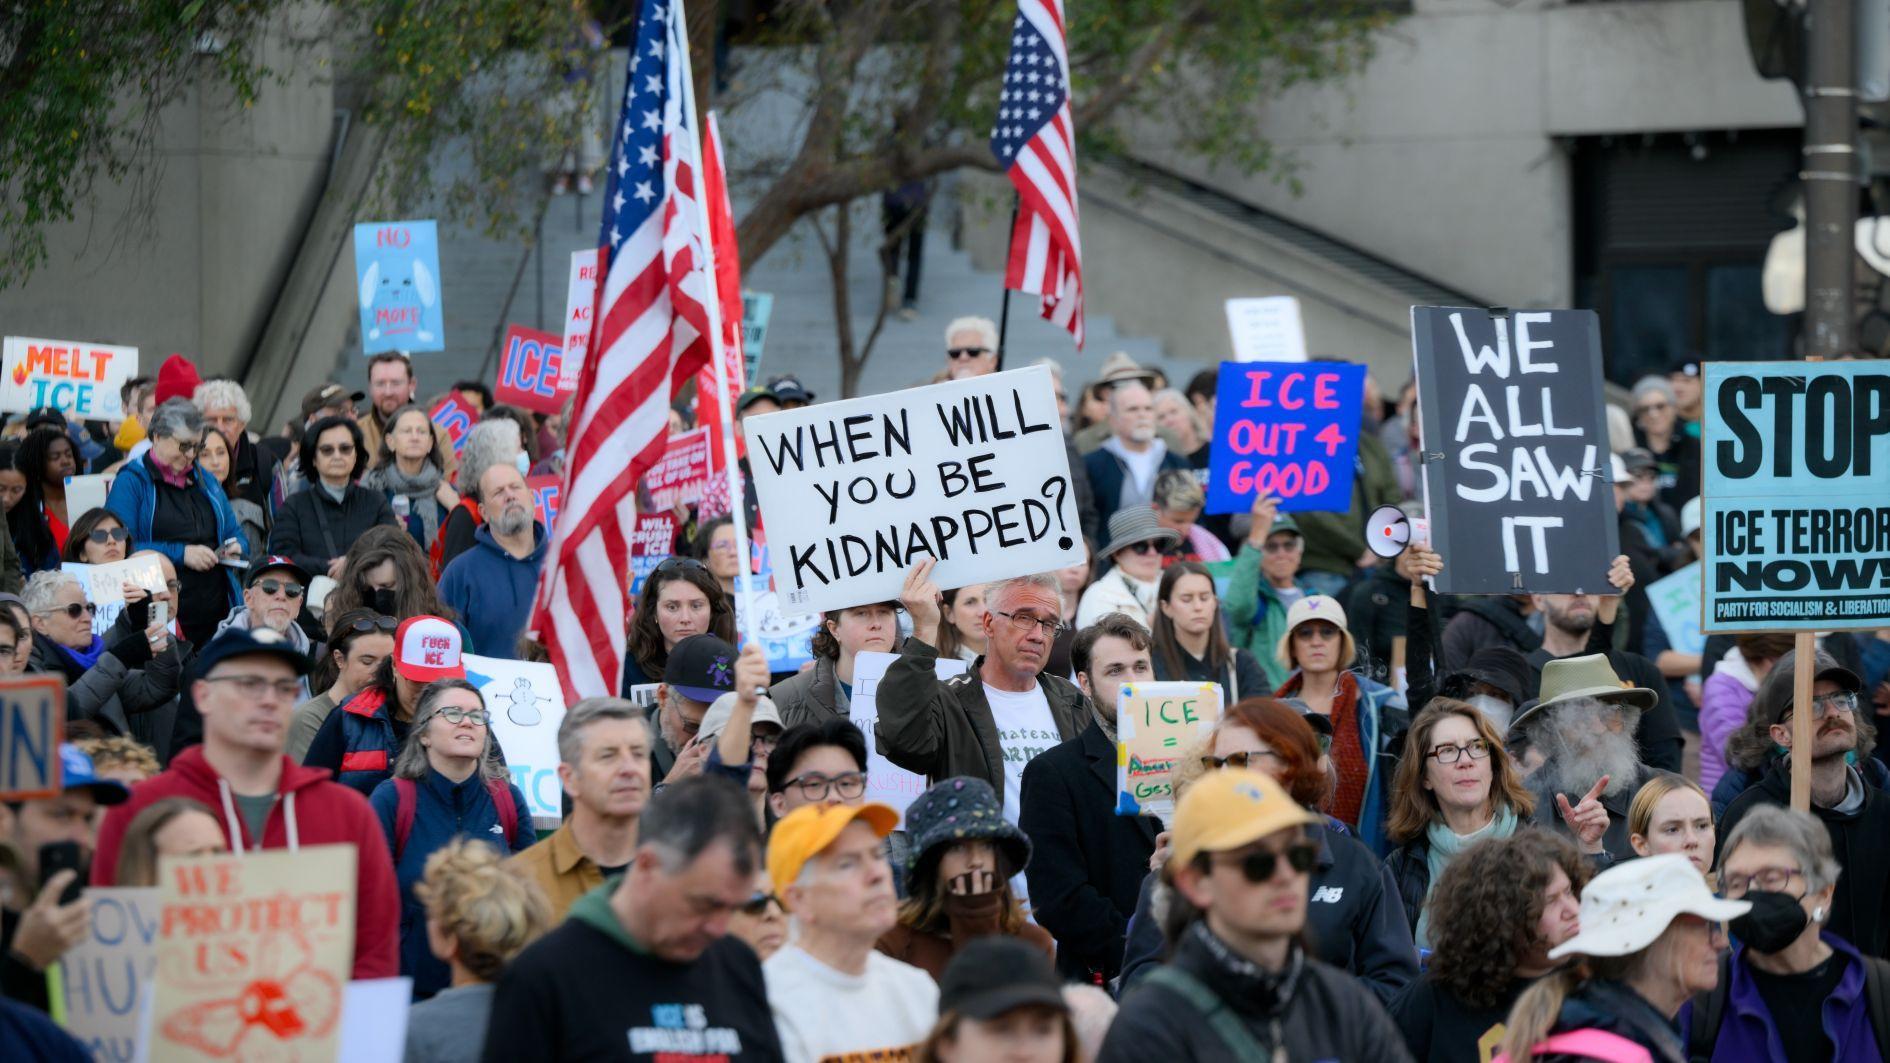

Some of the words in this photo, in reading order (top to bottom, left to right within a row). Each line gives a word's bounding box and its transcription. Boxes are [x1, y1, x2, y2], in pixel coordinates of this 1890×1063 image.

[377, 227, 411, 249] NO
[376, 305, 420, 327] MORE
[27, 344, 113, 383] MELT
[1448, 311, 1560, 379] WE
[502, 334, 565, 398] ICE
[29, 378, 94, 414] ICE
[1240, 371, 1341, 411] ICE
[757, 408, 912, 476] WHEN
[936, 388, 1052, 447] WILL
[1454, 383, 1585, 442] ALL
[1716, 374, 1890, 479] STOP
[1228, 419, 1307, 457] OUT
[1313, 422, 1347, 457] 4
[813, 469, 917, 525] YOU
[937, 452, 1006, 498] BE
[1228, 460, 1330, 498] GOOD
[1454, 442, 1598, 503] SAW
[641, 517, 674, 532] WILL
[789, 475, 1074, 589] KIDNAPPED?
[1715, 510, 1765, 556] ICE
[644, 543, 671, 556] ICE
[1501, 516, 1565, 575] IT
[1717, 602, 1748, 618] PARTY
[1749, 602, 1769, 617] FOR
[1770, 601, 1823, 617] SOCIALISM
[1825, 602, 1838, 616] &
[1145, 699, 1199, 728] ICE
[174, 864, 244, 896] WE
[1311, 885, 1344, 903] NB
[161, 888, 348, 941] PROTECT
